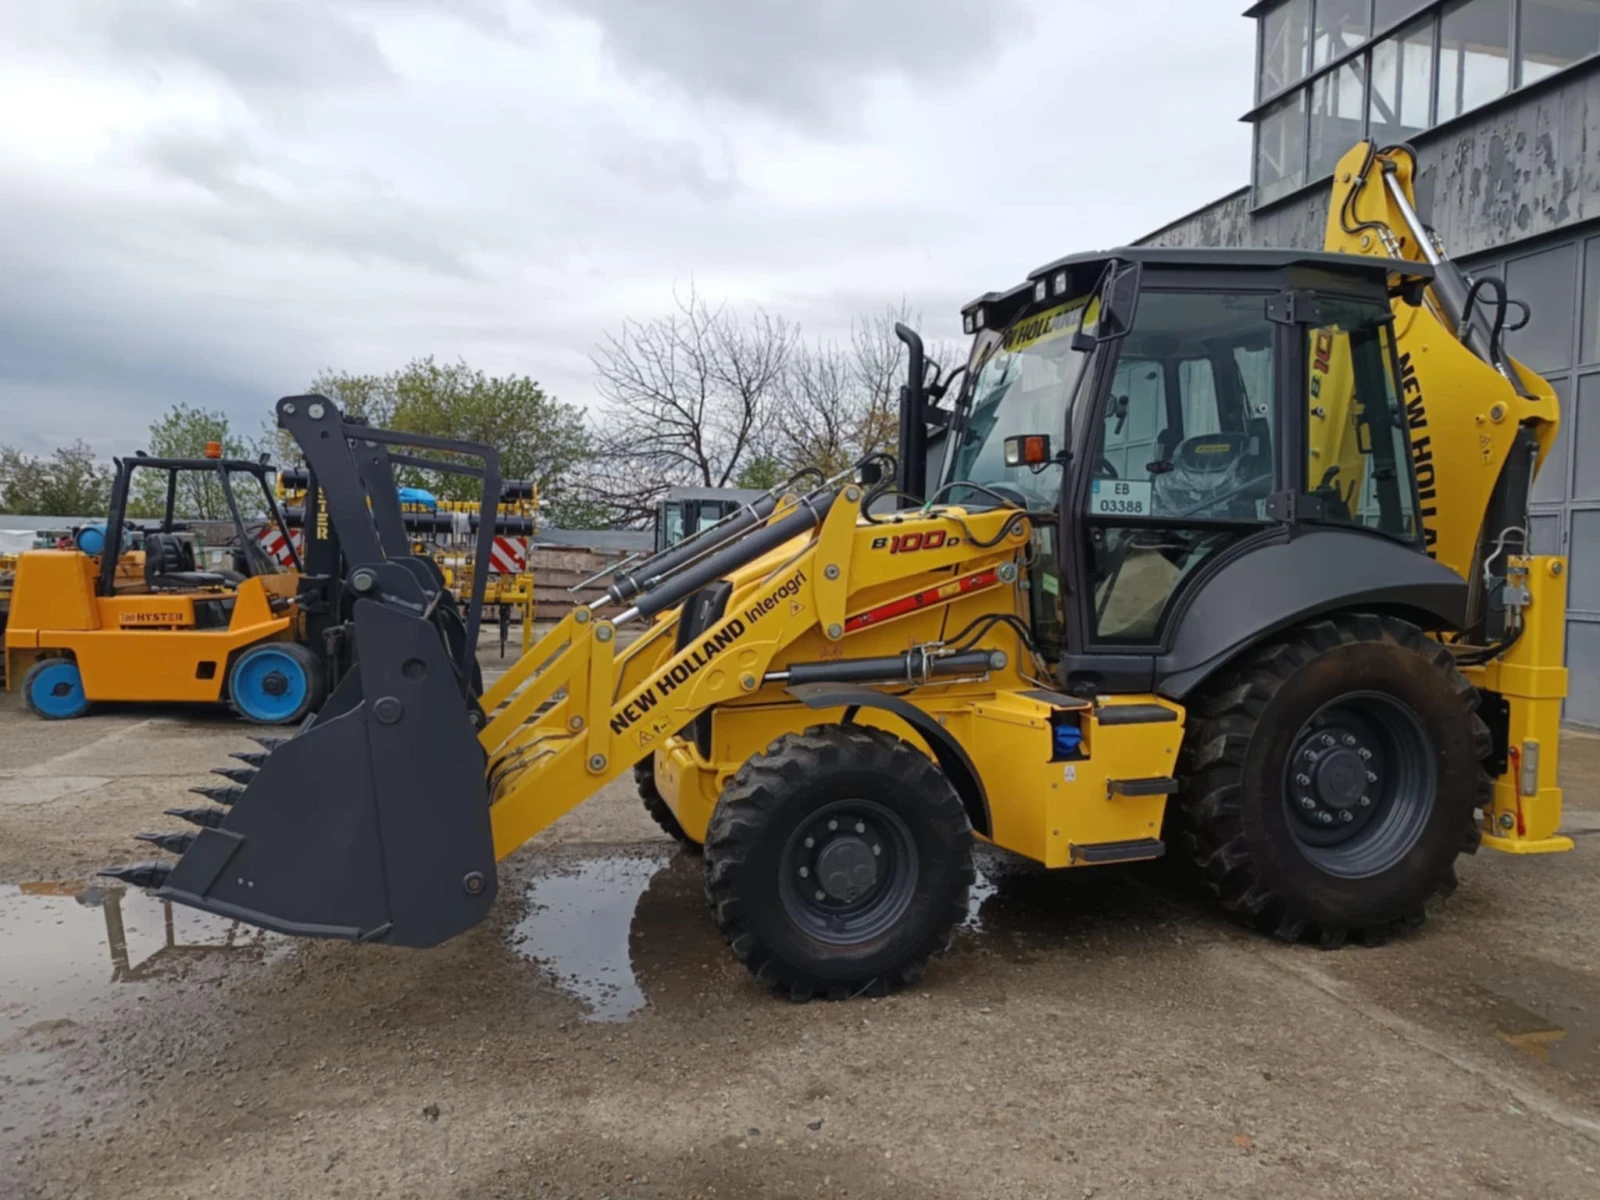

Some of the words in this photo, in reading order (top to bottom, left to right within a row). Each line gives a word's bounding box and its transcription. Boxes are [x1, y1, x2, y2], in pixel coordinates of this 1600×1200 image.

[1398, 352, 1428, 431] NEW
[1115, 483, 1130, 495] EB
[1100, 500, 1143, 513] 03388
[137, 613, 183, 621] HYSTER
[610, 690, 658, 735] NEW
[656, 620, 746, 696] HOLLAND
[744, 569, 807, 625] Interagri
